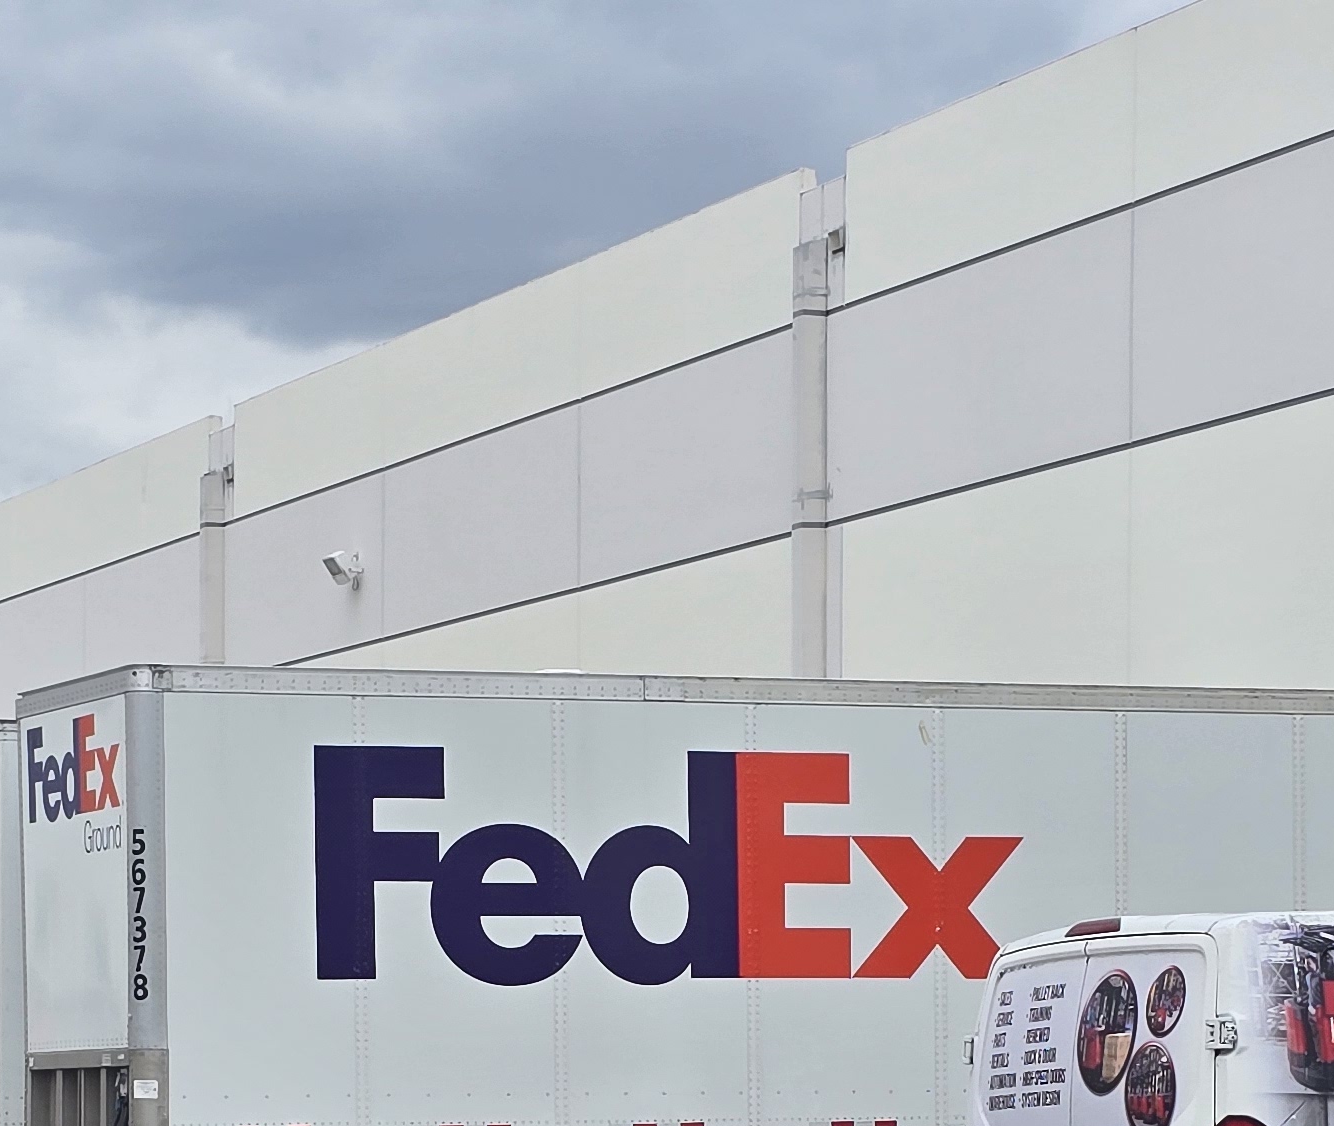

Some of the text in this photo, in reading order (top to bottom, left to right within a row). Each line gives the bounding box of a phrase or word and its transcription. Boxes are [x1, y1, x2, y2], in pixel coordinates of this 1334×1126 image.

[26, 713, 121, 824] FedEx
[83, 815, 122, 854] Ground
[131, 828, 149, 1001] 567378
[313, 744, 1024, 986] FedEx
